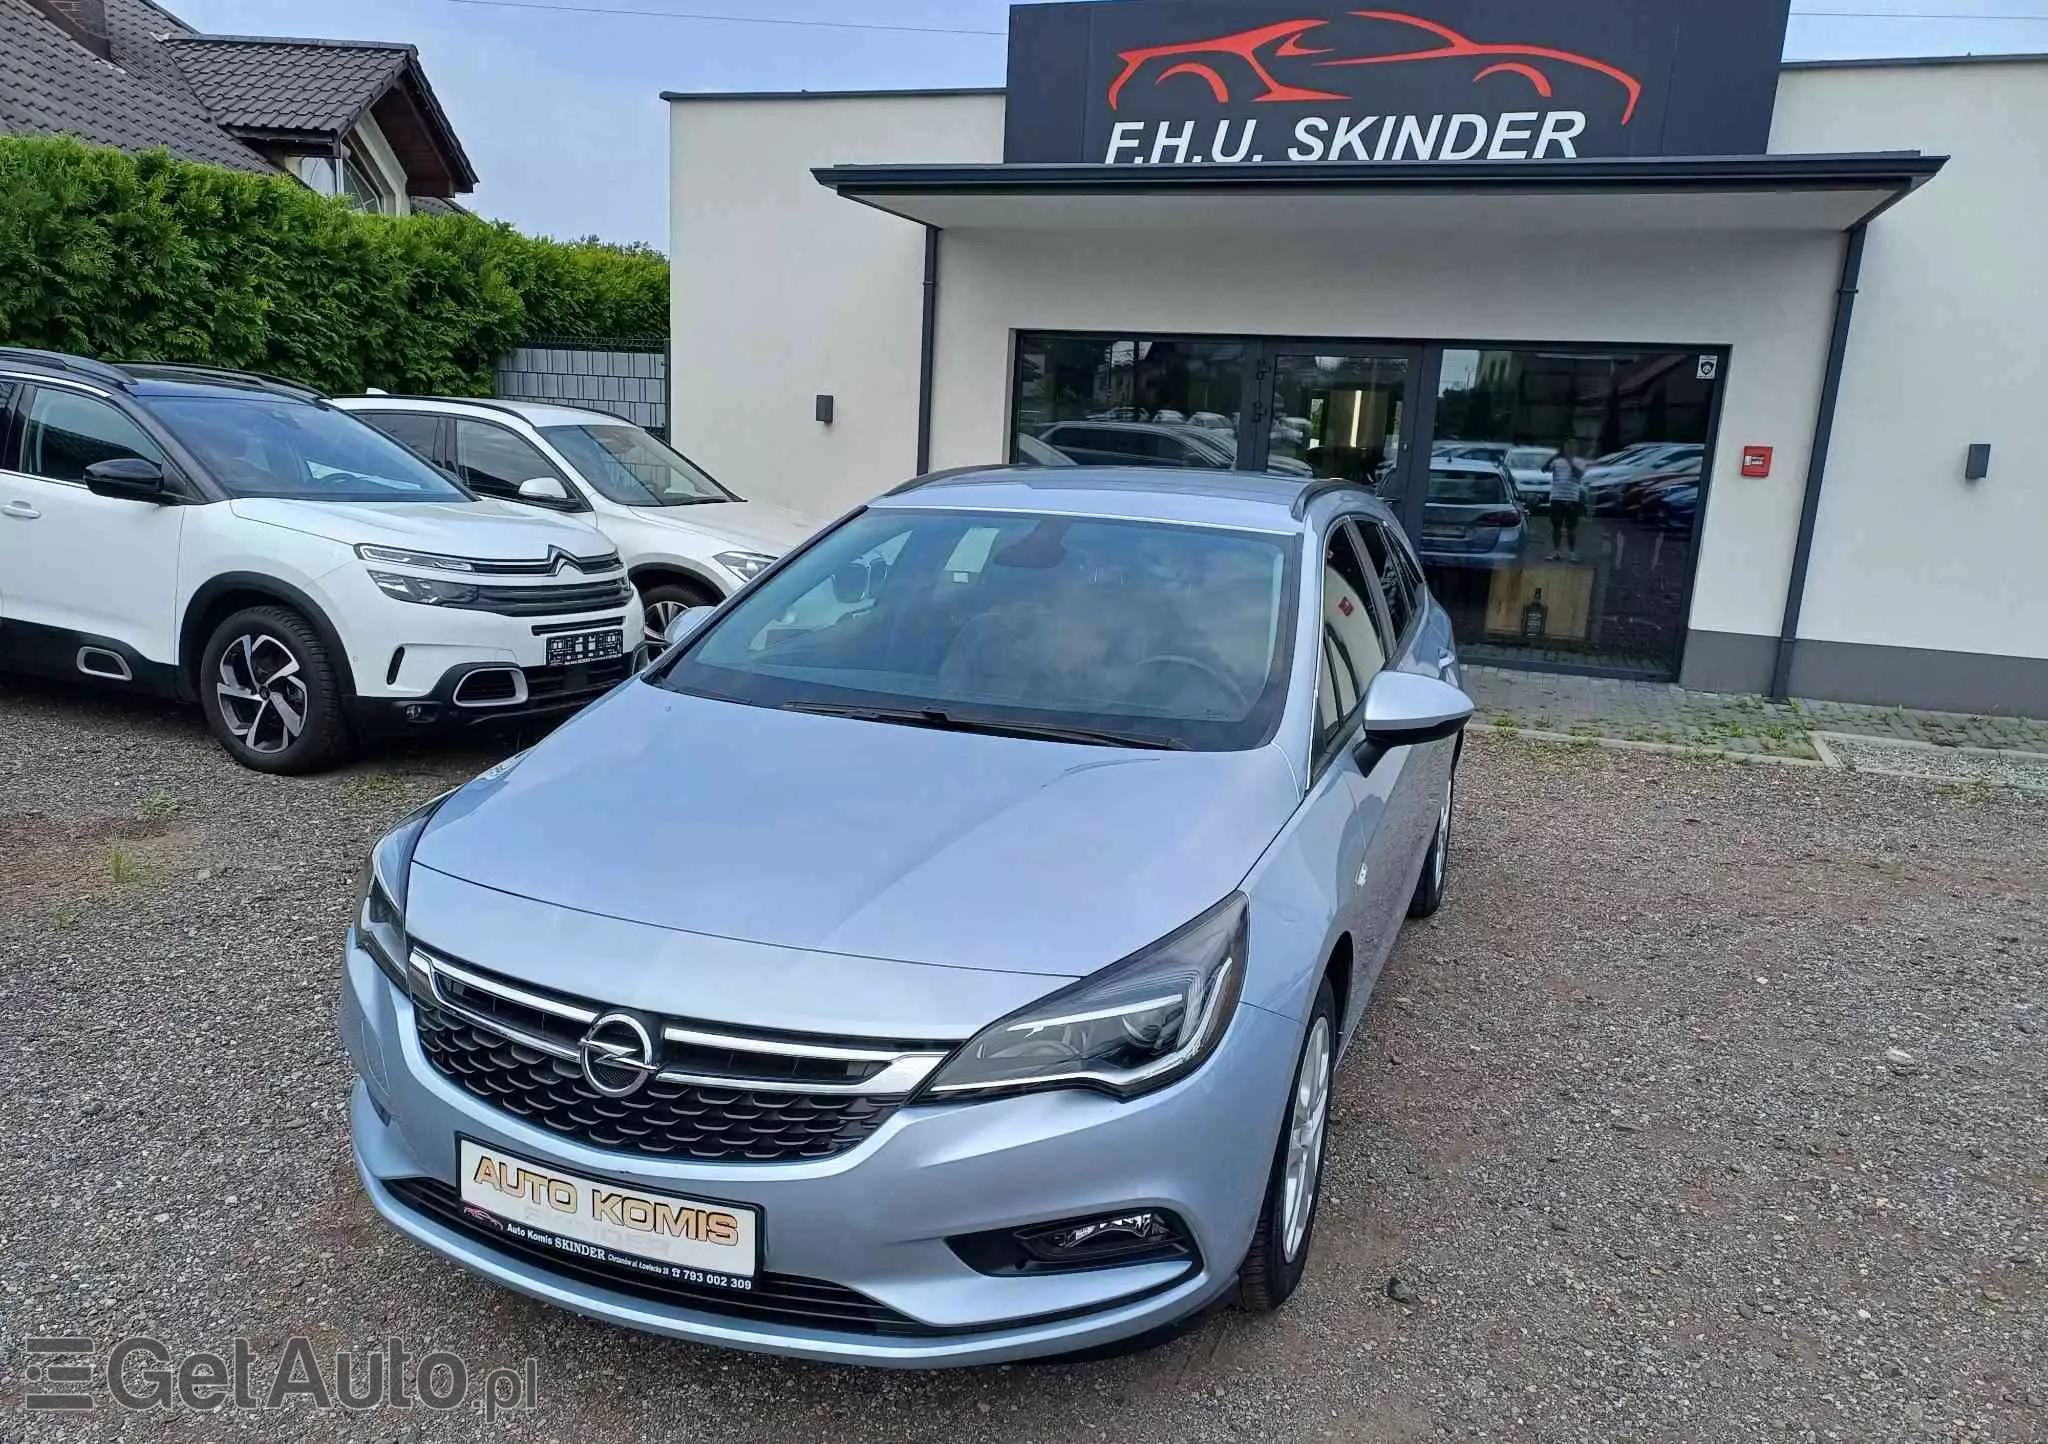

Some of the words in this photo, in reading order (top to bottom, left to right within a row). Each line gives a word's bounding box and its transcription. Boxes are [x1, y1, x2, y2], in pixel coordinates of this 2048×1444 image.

[1104, 119, 1263, 164] F.H.U.
[1287, 110, 1586, 162] SKINDER
[473, 1155, 578, 1214] AUTO
[592, 1188, 739, 1247] KOMIS
[507, 1223, 526, 1237] Auto
[527, 1229, 553, 1246] Komis
[554, 1237, 606, 1261] SKINDER
[683, 1269, 704, 1283] 793
[706, 1273, 728, 1287] 002
[730, 1276, 752, 1290] 309
